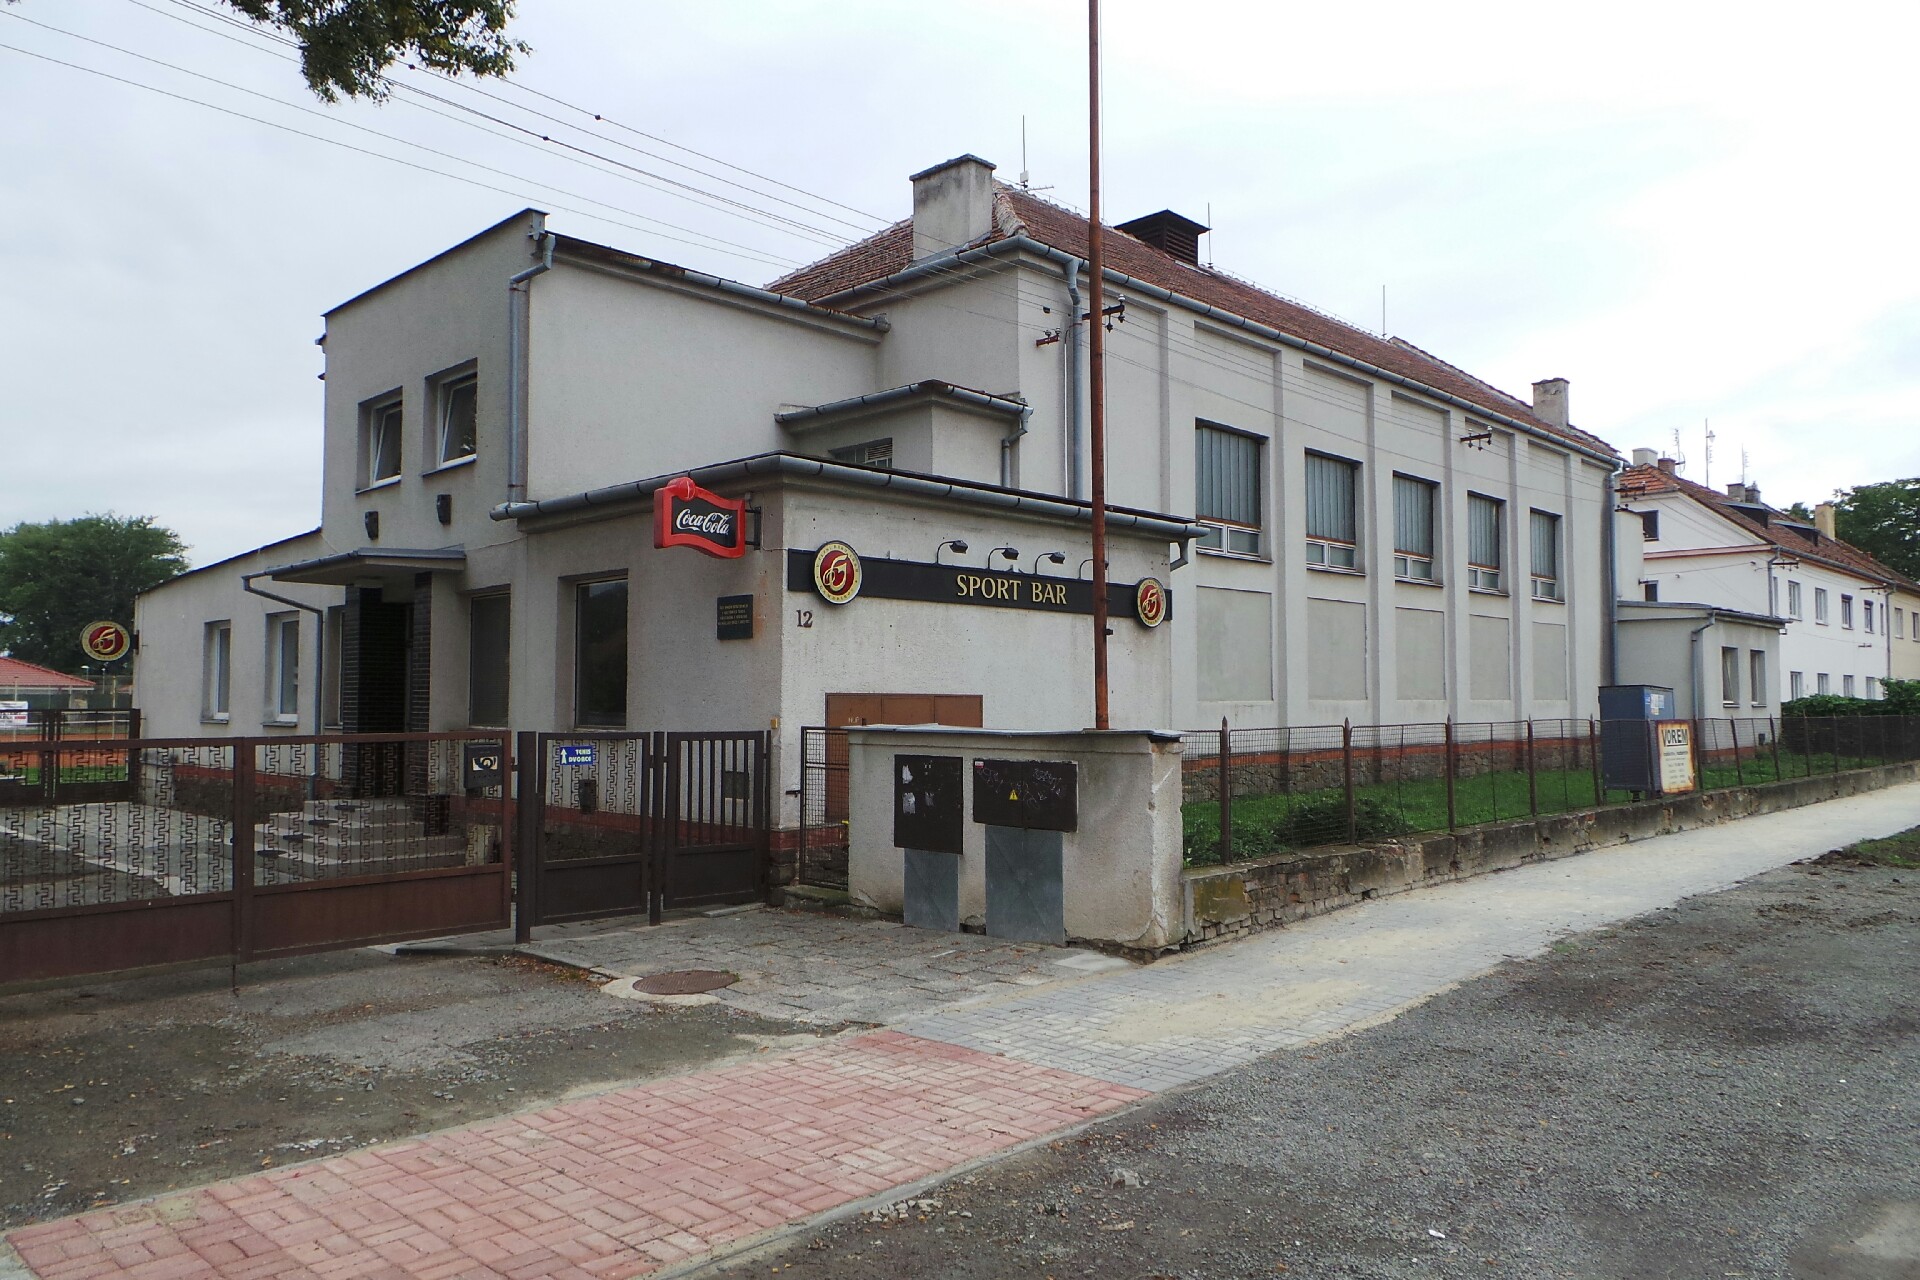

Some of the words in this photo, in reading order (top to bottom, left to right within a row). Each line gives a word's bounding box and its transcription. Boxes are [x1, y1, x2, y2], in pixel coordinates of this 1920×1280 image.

[676, 508, 732, 535] Coca-Cola
[956, 574, 1022, 601] SPORT
[1031, 582, 1067, 605] BAR
[796, 609, 813, 628] 12
